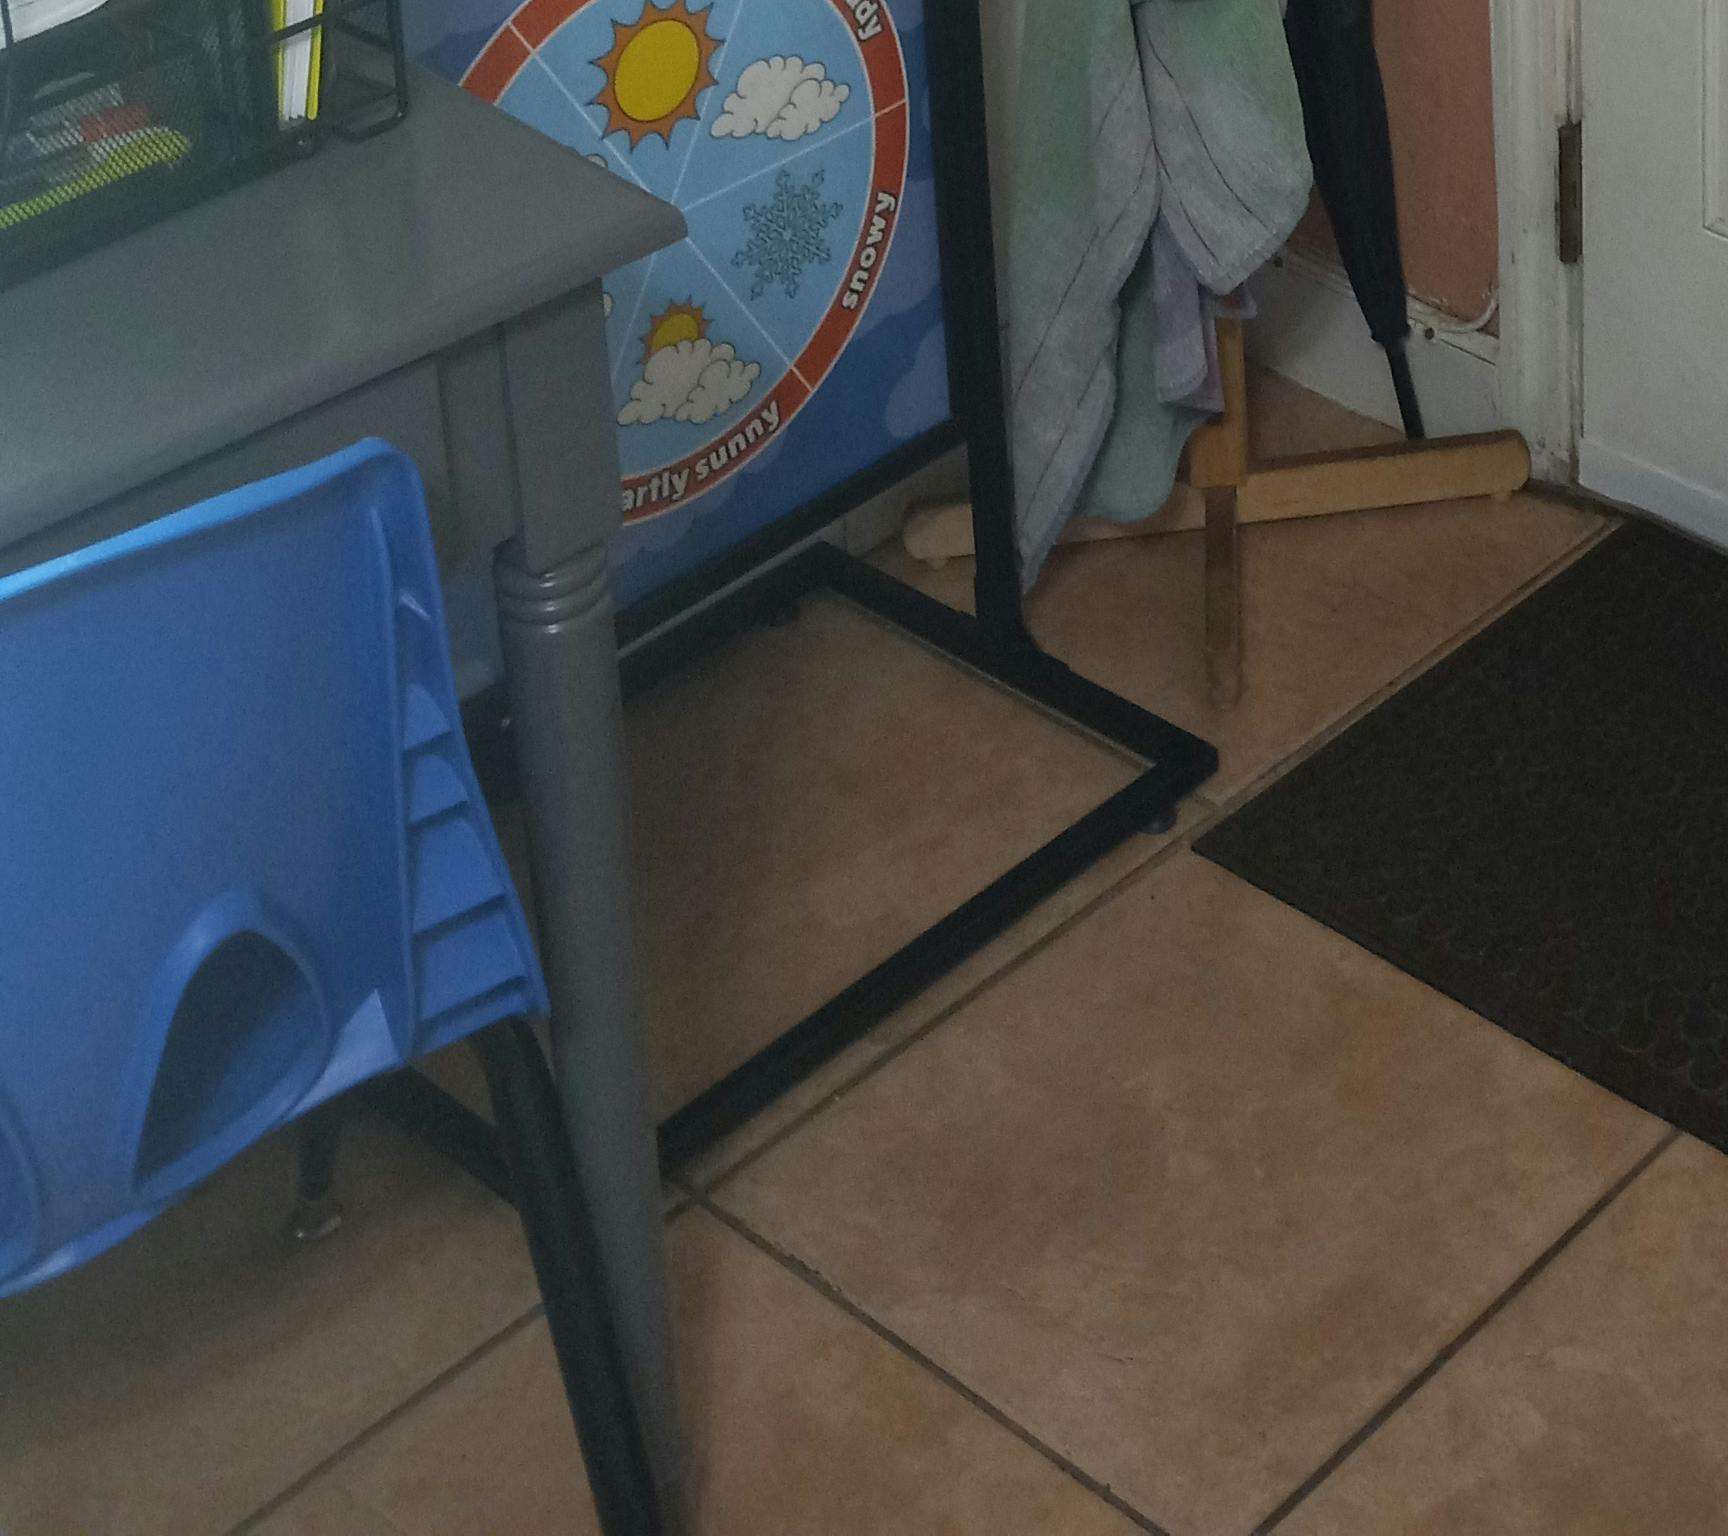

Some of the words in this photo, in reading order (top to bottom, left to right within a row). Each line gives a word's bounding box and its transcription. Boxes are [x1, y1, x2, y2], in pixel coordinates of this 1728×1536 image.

[842, 192, 896, 311] snowy
[621, 467, 688, 513] artly
[695, 401, 782, 481] sunny
